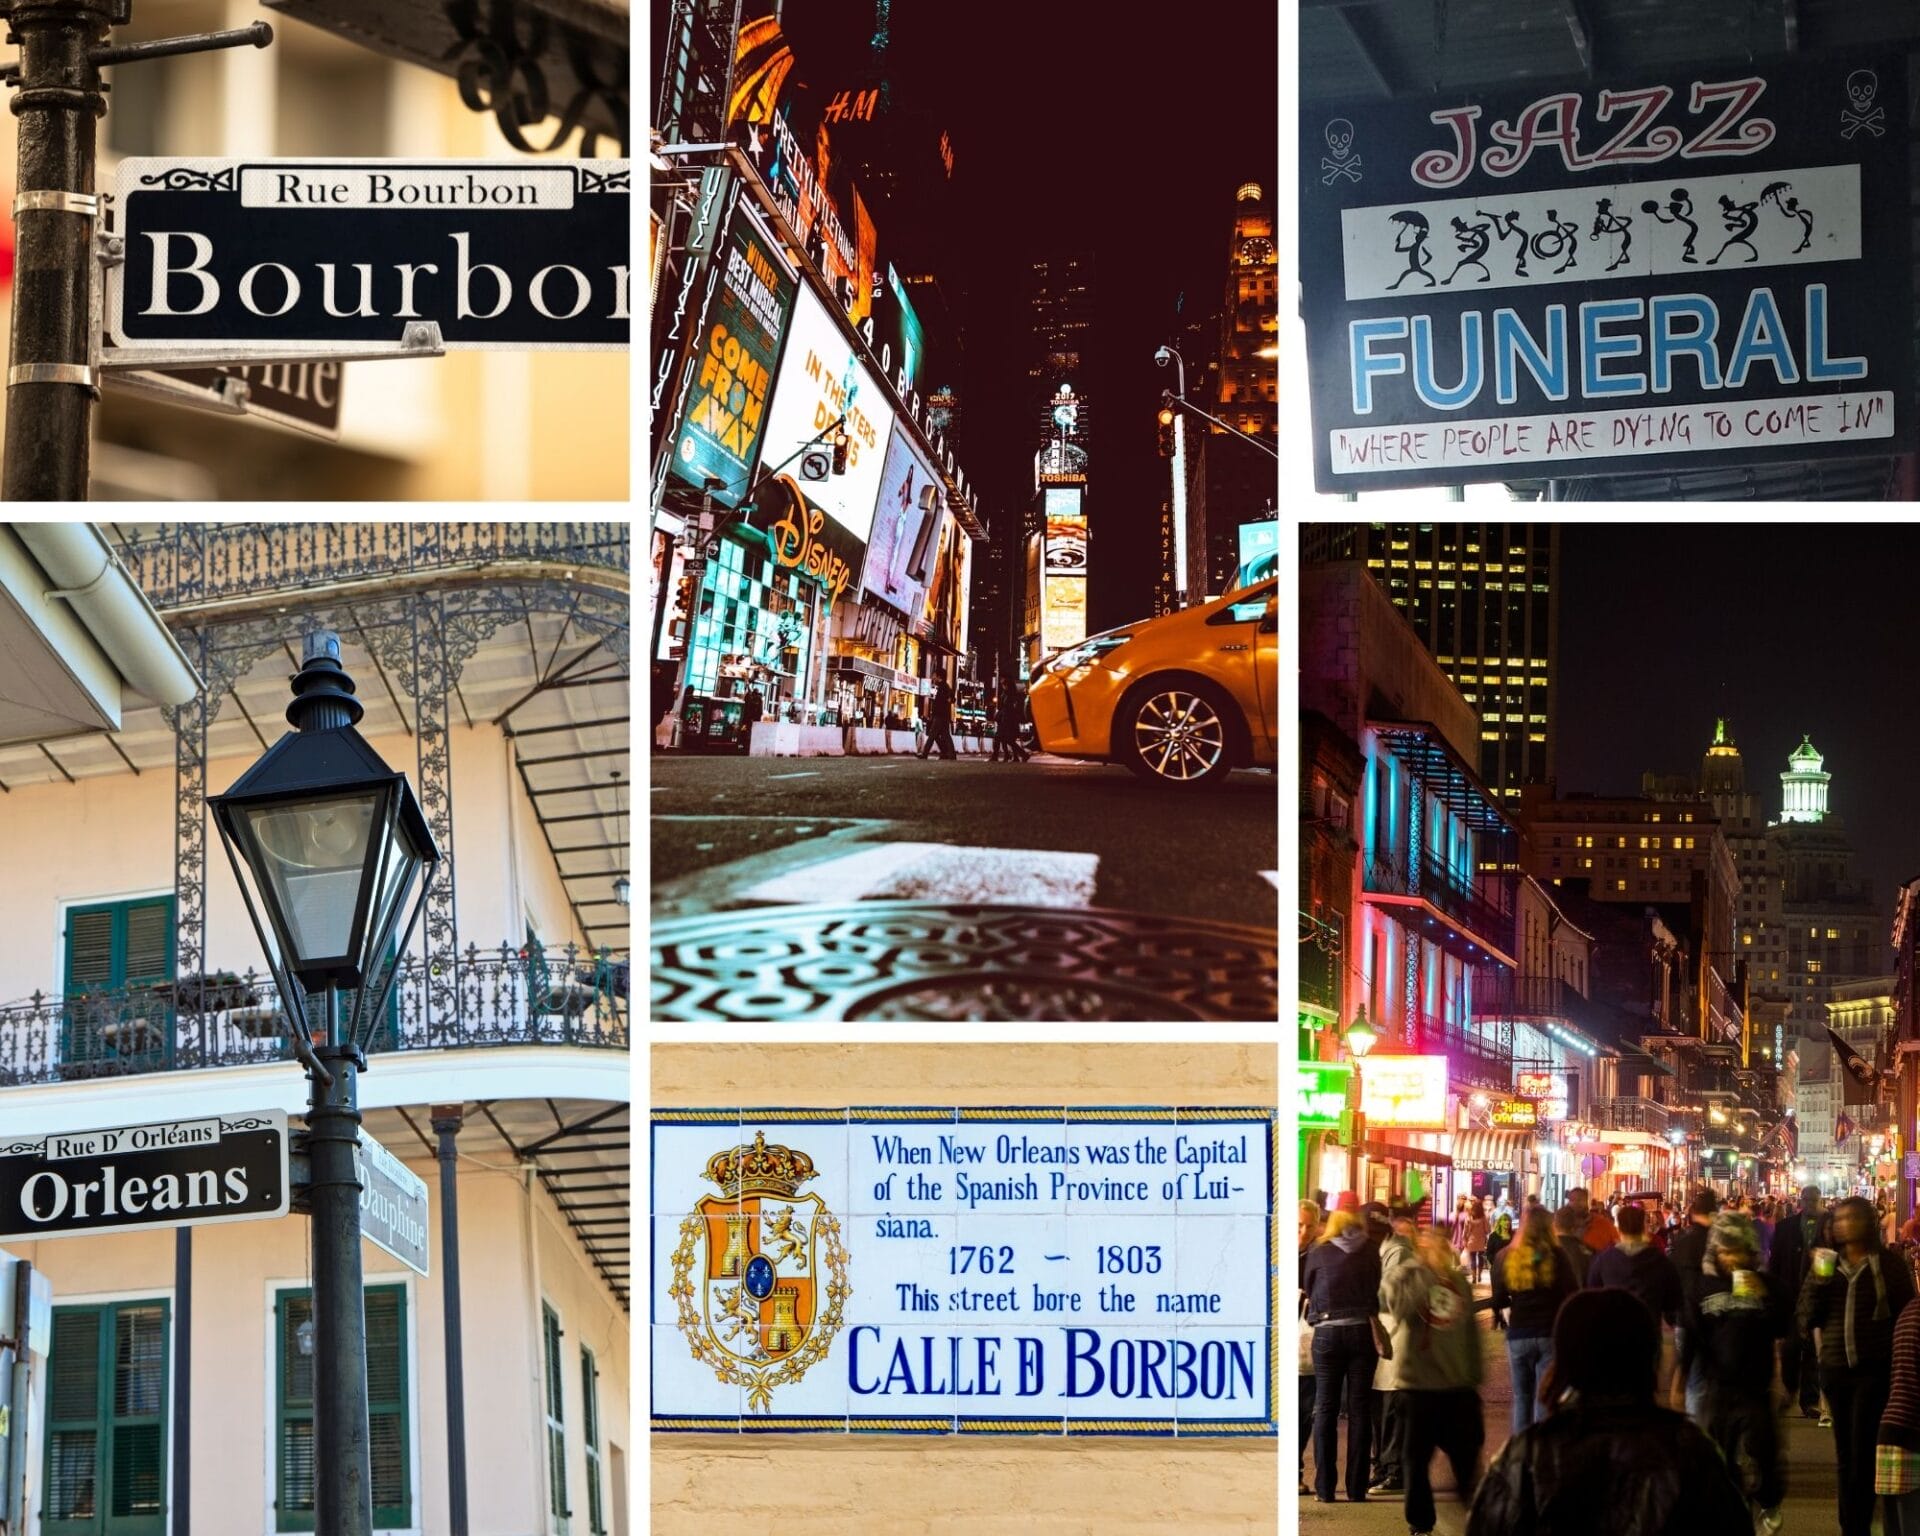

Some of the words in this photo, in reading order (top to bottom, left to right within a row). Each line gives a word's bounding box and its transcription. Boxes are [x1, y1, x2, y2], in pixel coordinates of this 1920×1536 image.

[1411, 76, 1777, 189] JAZZ
[276, 174, 349, 205] Rue
[367, 174, 539, 205] Bourbon
[727, 246, 752, 283] BEST
[749, 272, 783, 331] MUSICAL
[710, 323, 770, 402] COME
[805, 349, 822, 383] IN
[1348, 282, 1868, 415] FUNERAL
[689, 394, 756, 461] AWAY
[1340, 432, 1429, 466] "WHERE
[1442, 422, 1530, 461] PEOPLE
[1546, 419, 1596, 454] ARE
[1612, 411, 1693, 448] DYING
[1704, 409, 1733, 437] TO
[1744, 402, 1823, 435] COME
[1838, 397, 1885, 430] IN"
[1040, 473, 1088, 483] TOSHIBA
[55, 1138, 96, 1158] Rue
[131, 1124, 213, 1149] Orléans
[872, 1135, 933, 1165] When
[938, 1135, 984, 1165] New
[996, 1134, 1080, 1165] Orleans
[1085, 1143, 1131, 1165] was
[1134, 1135, 1168, 1165] the
[1175, 1134, 1248, 1178] Capital
[1453, 1160, 1484, 1170] CHRIS
[20, 1165, 249, 1222] Orleans
[360, 1163, 425, 1251] Dauphine
[873, 1172, 895, 1202] of
[907, 1171, 943, 1202] the
[956, 1171, 1039, 1209] Spanish
[1051, 1171, 1149, 1202] Province
[1162, 1171, 1188, 1202] of
[875, 1211, 940, 1240] siana.
[949, 1244, 1016, 1275] 1762
[1096, 1244, 1163, 1275] 1803
[895, 1283, 940, 1313] This
[948, 1283, 1019, 1313] street
[1033, 1283, 1082, 1313] bore
[1099, 1283, 1137, 1313] the
[1156, 1289, 1222, 1314] name
[848, 1325, 1002, 1396] CALLE
[1057, 1326, 1256, 1400] BORBON
